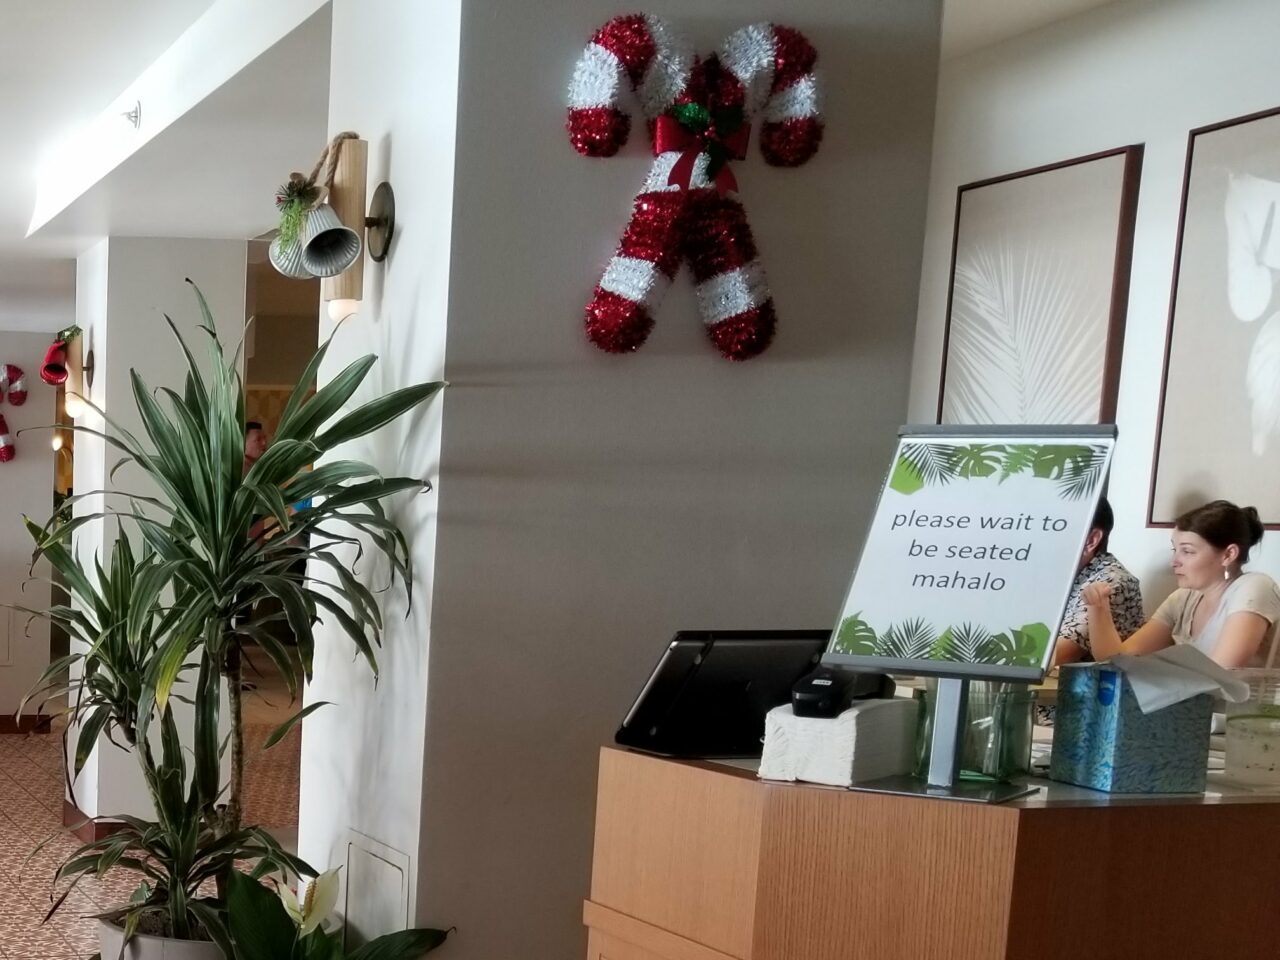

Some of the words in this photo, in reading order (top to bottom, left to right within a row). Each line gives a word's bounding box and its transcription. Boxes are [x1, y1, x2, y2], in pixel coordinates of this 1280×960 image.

[891, 509, 971, 531] please
[980, 513, 1035, 531] wait
[1042, 515, 1068, 532] to
[908, 538, 938, 558] be
[945, 543, 1032, 561] seated
[912, 570, 1006, 591] mahalo
